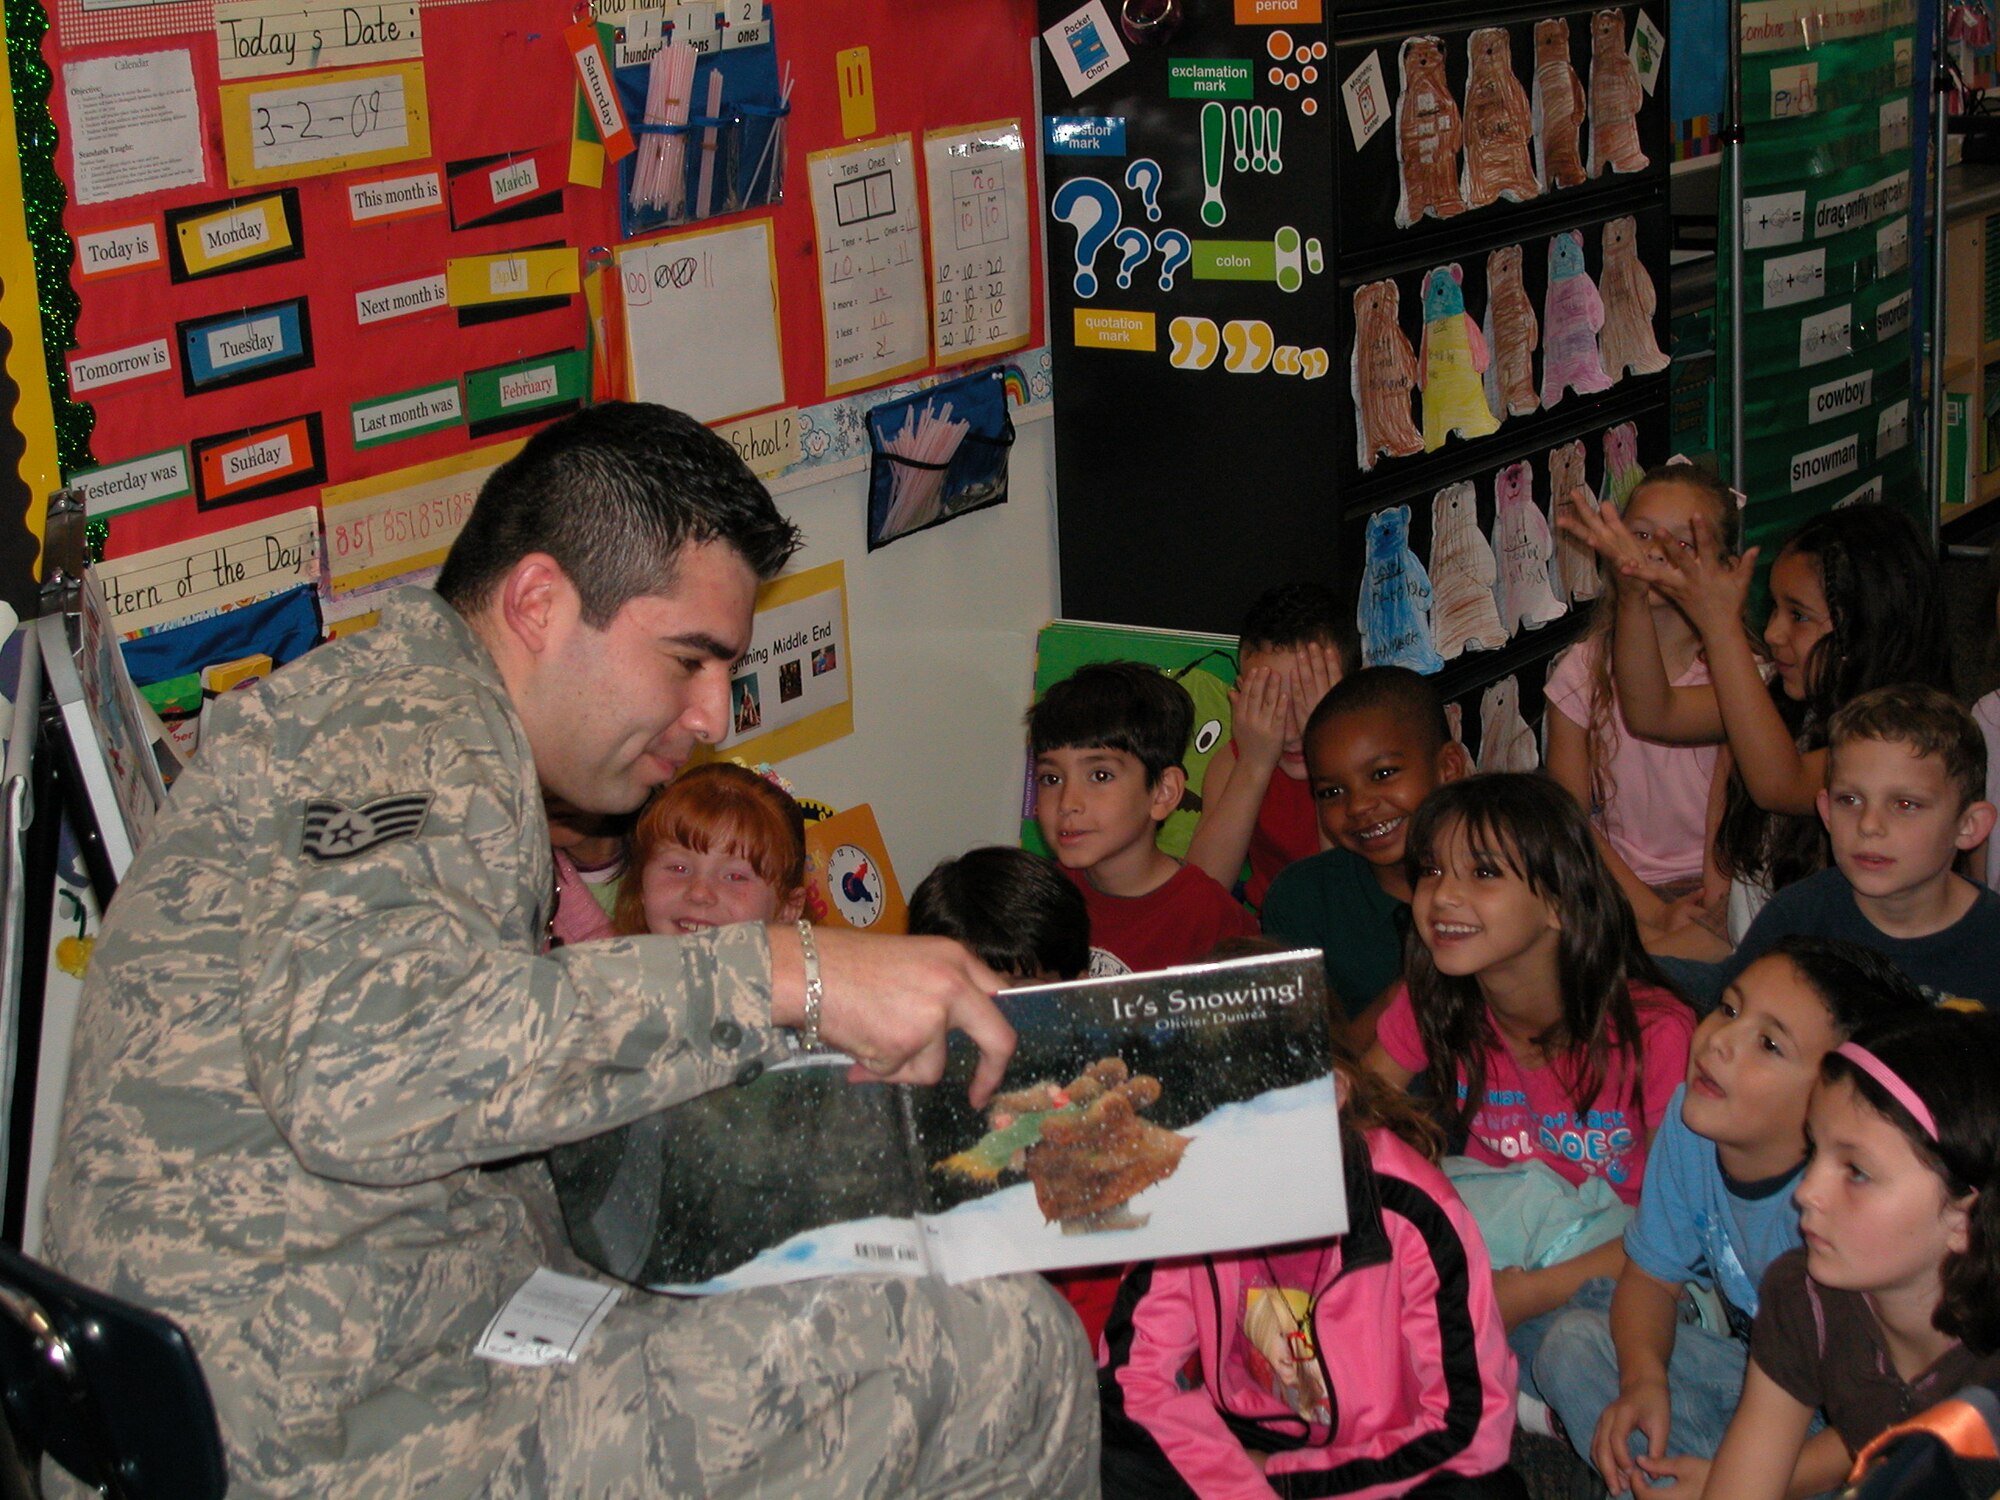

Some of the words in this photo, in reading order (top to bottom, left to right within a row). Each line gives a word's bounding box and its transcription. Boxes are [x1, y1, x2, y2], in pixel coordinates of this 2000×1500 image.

[1256, 0, 1298, 13] period
[343, 7, 415, 48] Date:
[738, 29, 759, 43] ones
[1064, 14, 1091, 35] Pocket
[115, 59, 149, 71] Calendar
[1086, 61, 1110, 79] Chart
[1171, 65, 1248, 78] exclamation
[584, 54, 614, 127] Saturday
[1194, 79, 1227, 92] mark
[257, 90, 382, 146] 3-2-09
[1055, 124, 1111, 141] stion
[1069, 137, 1100, 149] mark
[841, 164, 858, 177] Tens
[868, 157, 886, 170] Ones
[355, 190, 383, 209] This
[386, 185, 425, 204] month
[427, 182, 438, 197] is
[495, 171, 532, 196] March
[1817, 193, 1870, 228] dragonfly
[208, 221, 263, 248] Monday
[88, 240, 132, 262] Today
[135, 238, 149, 254] is
[1216, 255, 1250, 267] colon
[361, 297, 390, 316] Next
[393, 288, 431, 311] month
[434, 285, 445, 299] is
[1085, 317, 1143, 331] quotation
[1099, 330, 1130, 342] mark
[220, 334, 275, 359] Tuesday
[75, 353, 150, 383] Tomorrow
[153, 347, 166, 364] is
[502, 377, 552, 400] February
[1817, 381, 1866, 412] cowboy
[361, 415, 387, 433] Last
[390, 406, 426, 427] month
[427, 398, 453, 413] was
[230, 446, 281, 474] Sunday
[1793, 443, 1856, 481] snowman
[78, 472, 148, 501] Yesterday
[150, 465, 178, 481] was
[102, 576, 163, 616] ttern
[177, 557, 193, 597] of
[214, 548, 245, 586] the
[728, 648, 768, 675] ginning
[773, 632, 808, 656] Middle
[812, 621, 832, 642] End
[1113, 994, 1158, 1020] It's
[1168, 975, 1304, 1014] Snowing!
[1154, 1013, 1207, 1031] Olivier
